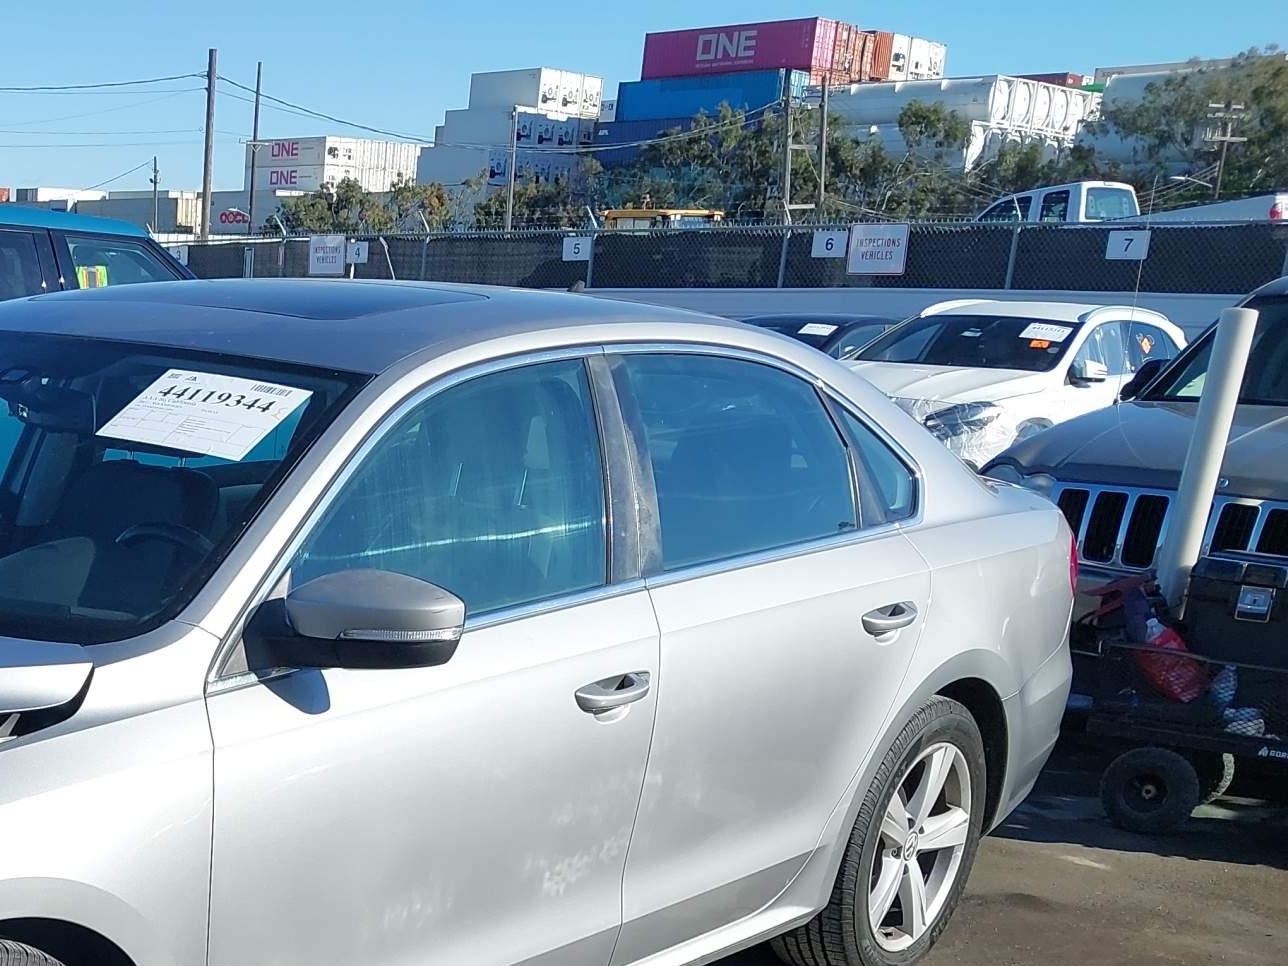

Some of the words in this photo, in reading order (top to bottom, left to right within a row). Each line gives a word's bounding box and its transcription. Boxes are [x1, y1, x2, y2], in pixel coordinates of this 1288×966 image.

[696, 30, 758, 60] ONE
[272, 142, 299, 157] ONE
[270, 170, 298, 185] ONE
[573, 243, 580, 254] 5
[825, 238, 834, 251] 6
[856, 238, 901, 248] INSPECTIONS
[1124, 238, 1134, 252] 7
[355, 247, 361, 258] 4
[861, 250, 894, 260] VEHICLES
[158, 385, 277, 412] 44119344
